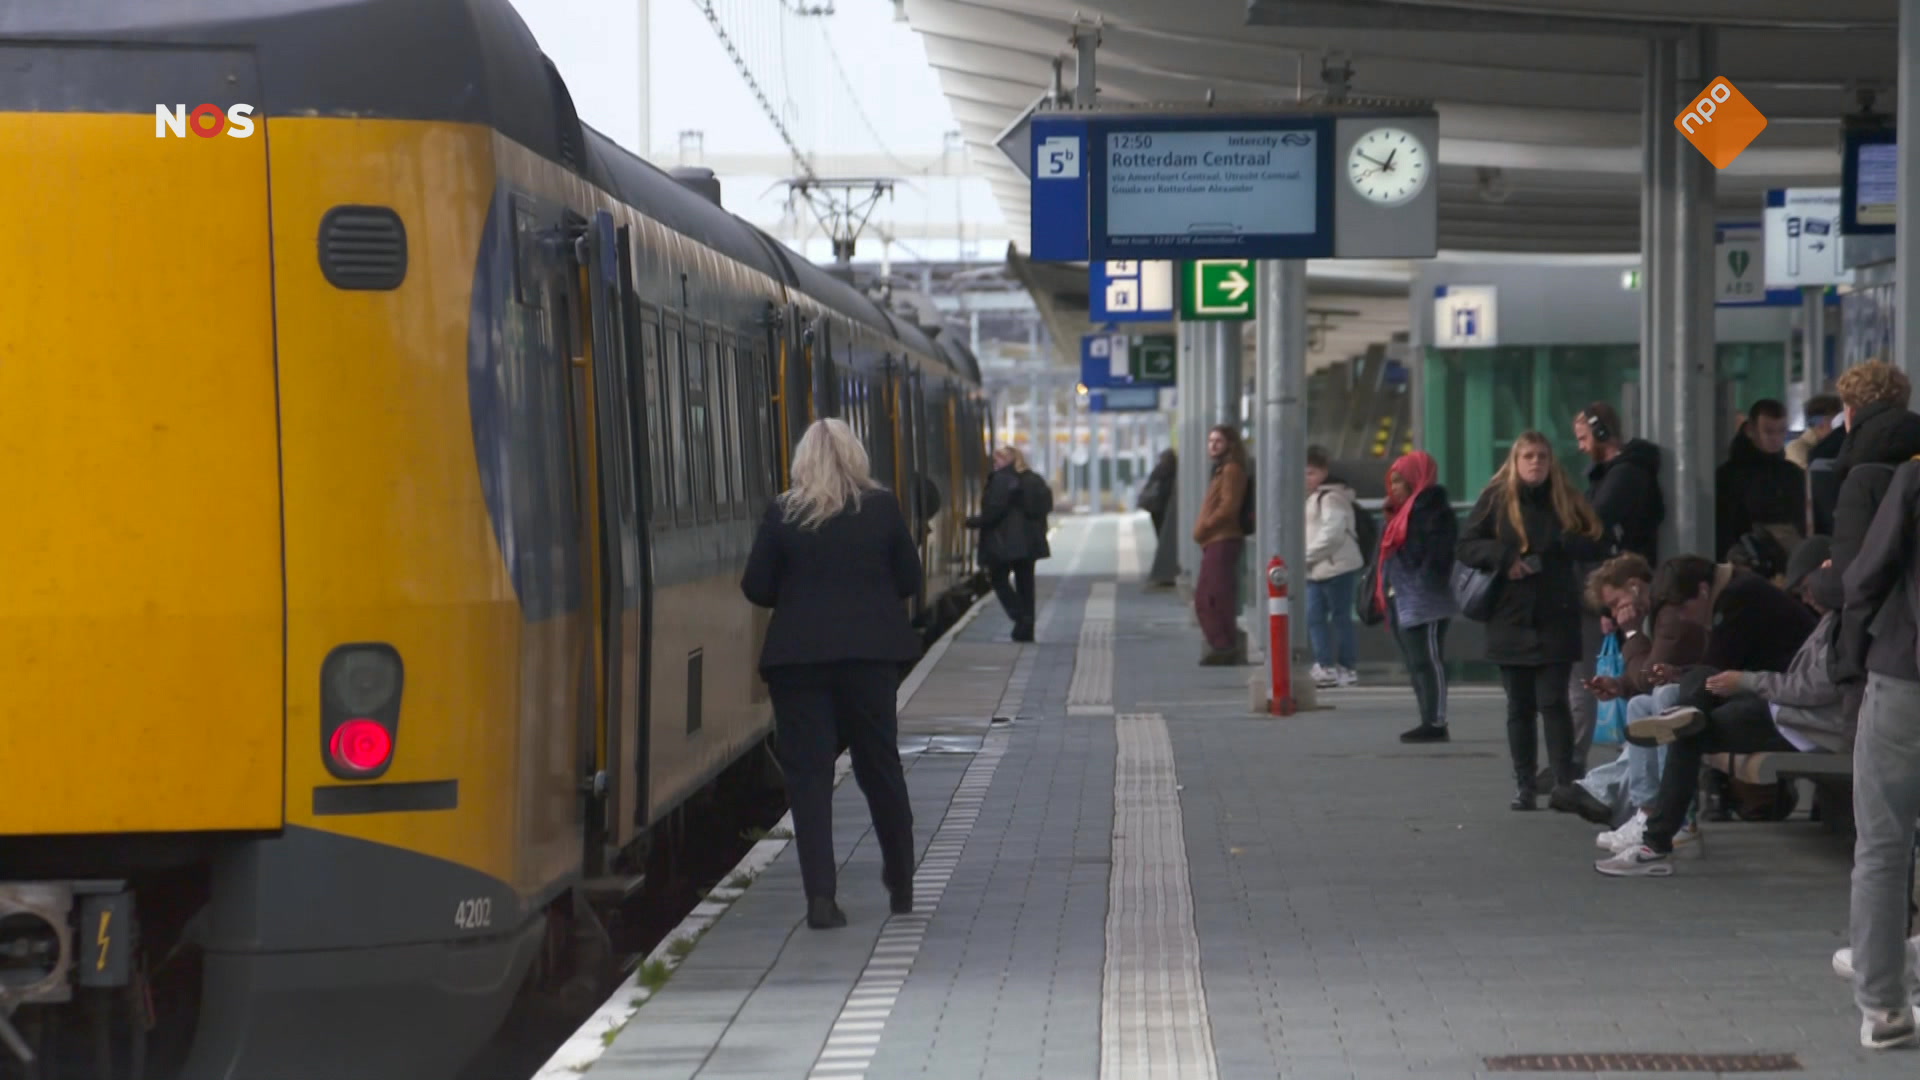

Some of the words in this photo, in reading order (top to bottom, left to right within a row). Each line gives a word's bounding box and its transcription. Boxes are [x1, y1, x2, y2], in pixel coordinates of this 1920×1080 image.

[1113, 136, 1152, 149] 12:50
[1228, 135, 1277, 147] Intercity
[1112, 152, 1197, 167] Rotterdam
[1203, 151, 1271, 166] Centraal
[454, 897, 491, 929] 4202
